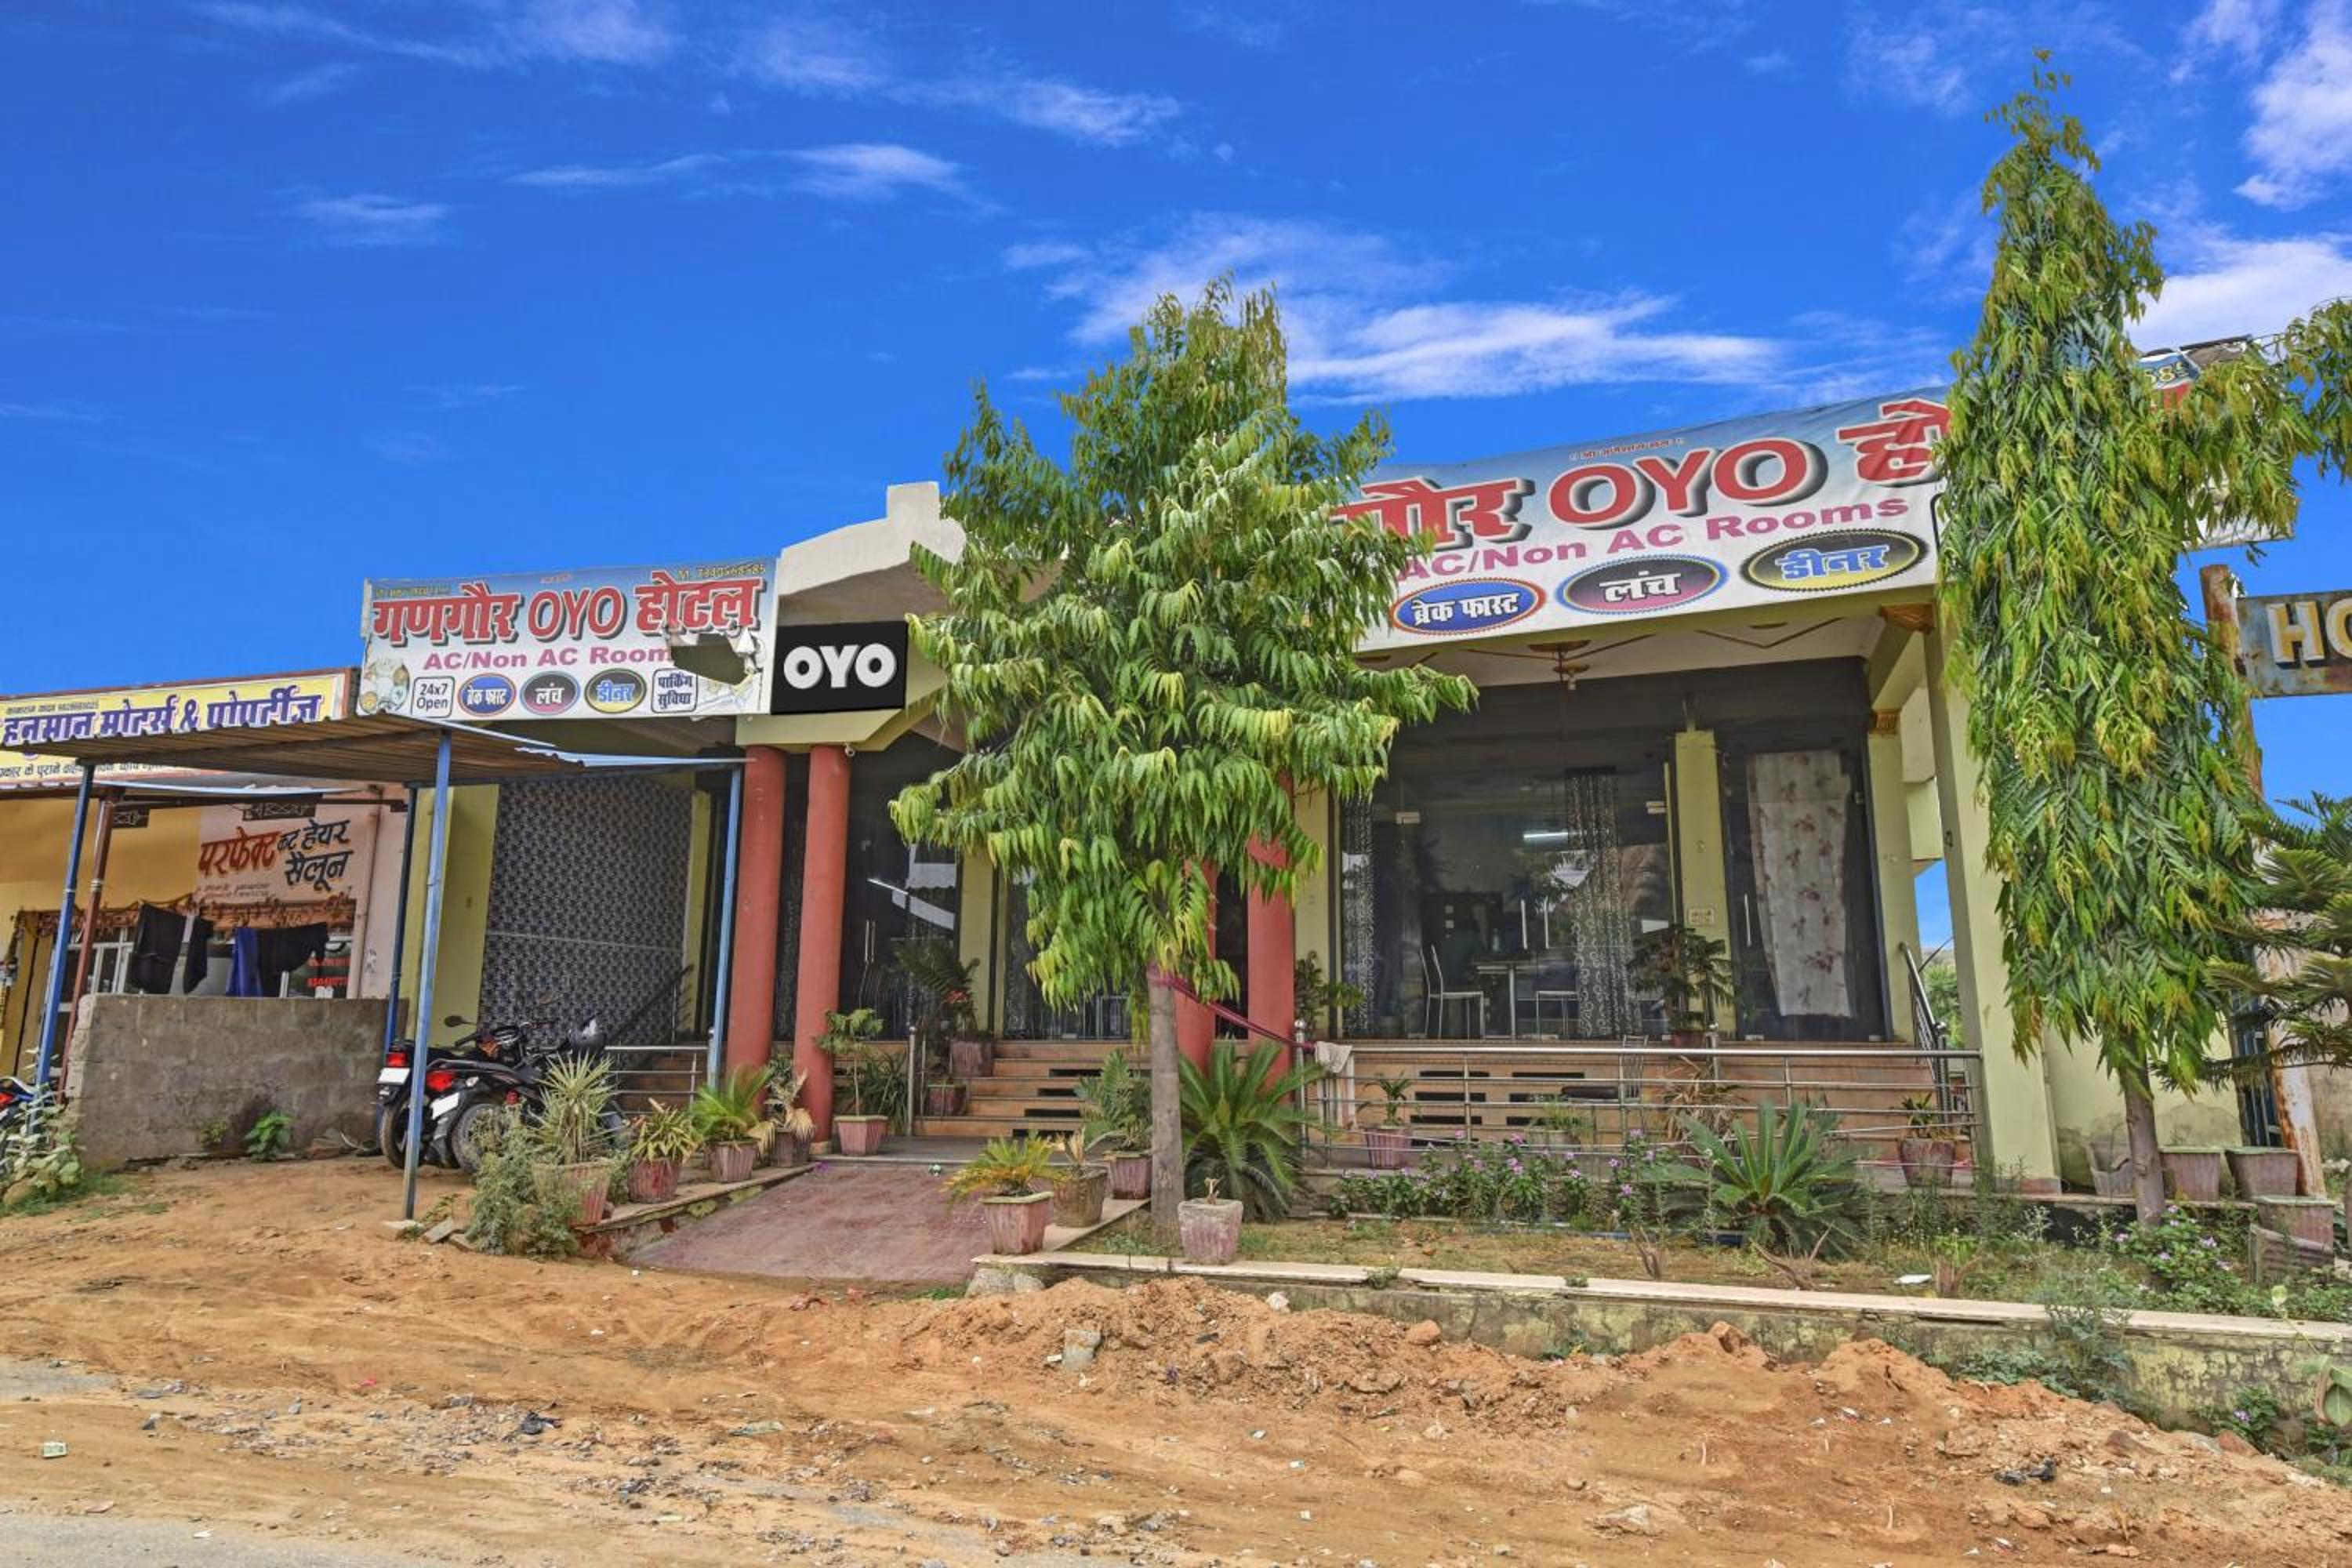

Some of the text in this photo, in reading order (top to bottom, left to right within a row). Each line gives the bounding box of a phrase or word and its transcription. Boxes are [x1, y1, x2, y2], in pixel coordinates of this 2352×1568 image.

[1547, 437, 1824, 530] OYO
[1397, 498, 1909, 581] AC/Non AC Rooms
[1775, 545, 1889, 580] डीनर
[1599, 570, 1682, 602] लंच
[372, 570, 765, 647] गणगौर OYO होटल
[1412, 593, 1519, 626] ब्रेक फास्ट
[423, 646, 671, 670] AC/Non AC Room
[783, 643, 897, 690] OYO
[416, 696, 448, 712] Open
[420, 683, 448, 696] 24x7
[535, 682, 564, 705] लंच
[179, 699, 199, 731] &
[198, 826, 280, 877] परफेक्ट
[303, 818, 351, 851] हेयर
[284, 850, 354, 892] सैलून
